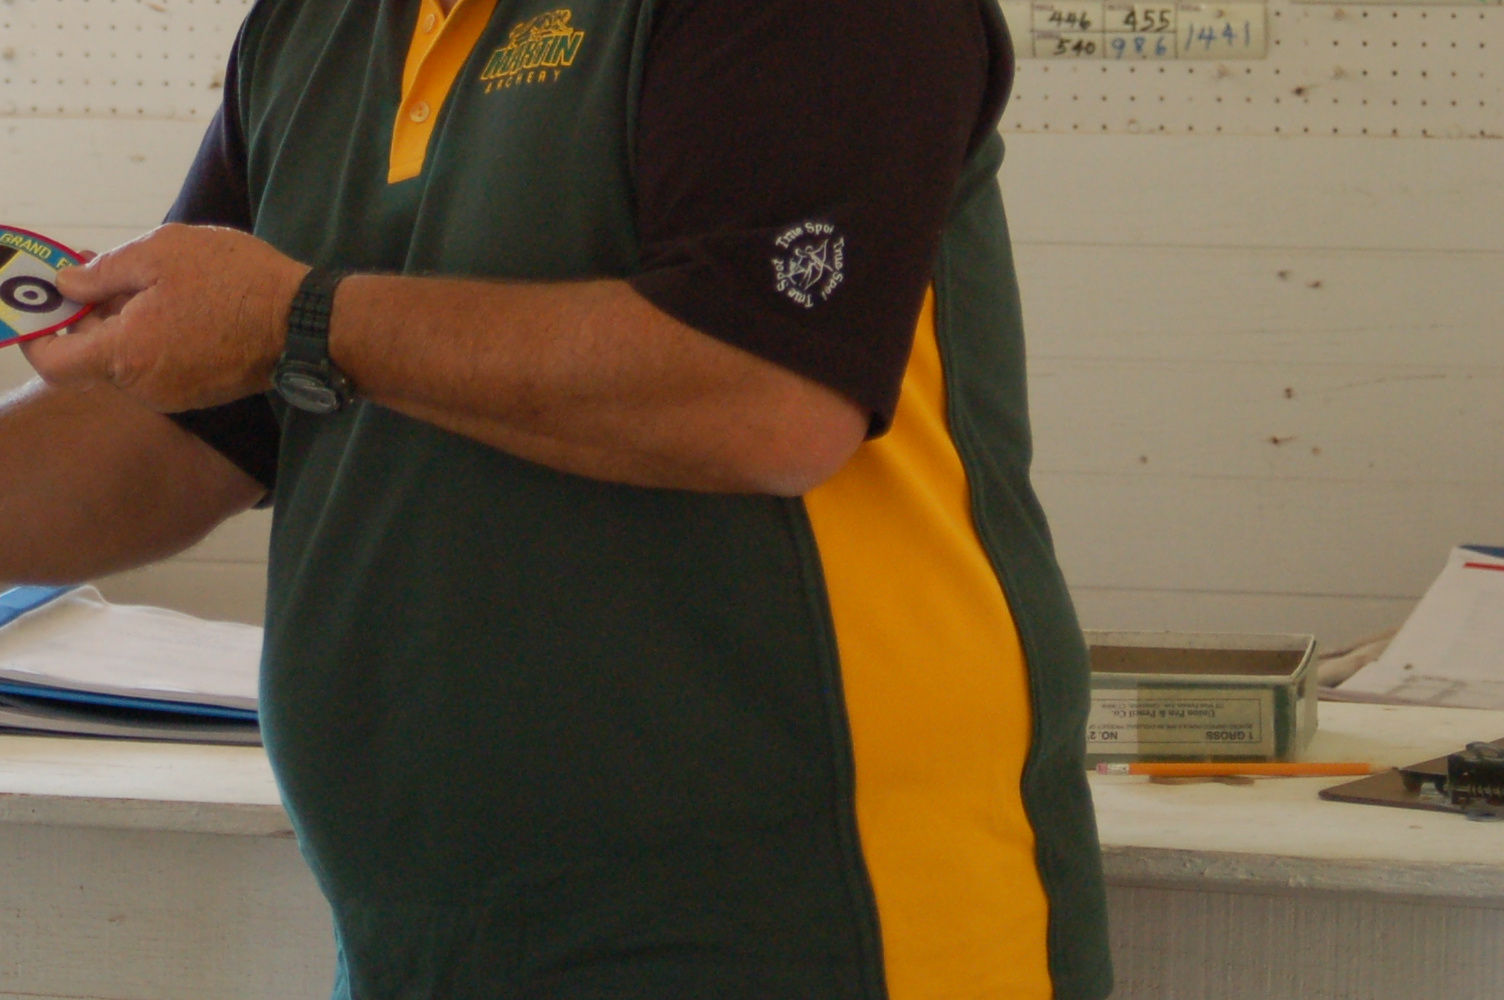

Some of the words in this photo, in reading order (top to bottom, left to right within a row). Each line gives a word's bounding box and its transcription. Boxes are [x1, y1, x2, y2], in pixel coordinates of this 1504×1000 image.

[1048, 11, 1092, 31] 446
[1122, 8, 1172, 34] 455
[1184, 19, 1252, 53] 1441
[480, 31, 585, 80] MARTIN
[1053, 38, 1096, 57] 540
[1110, 34, 1168, 60] 986
[1099, 730, 1119, 741] NO.
[1205, 730, 1246, 741] GROSS
